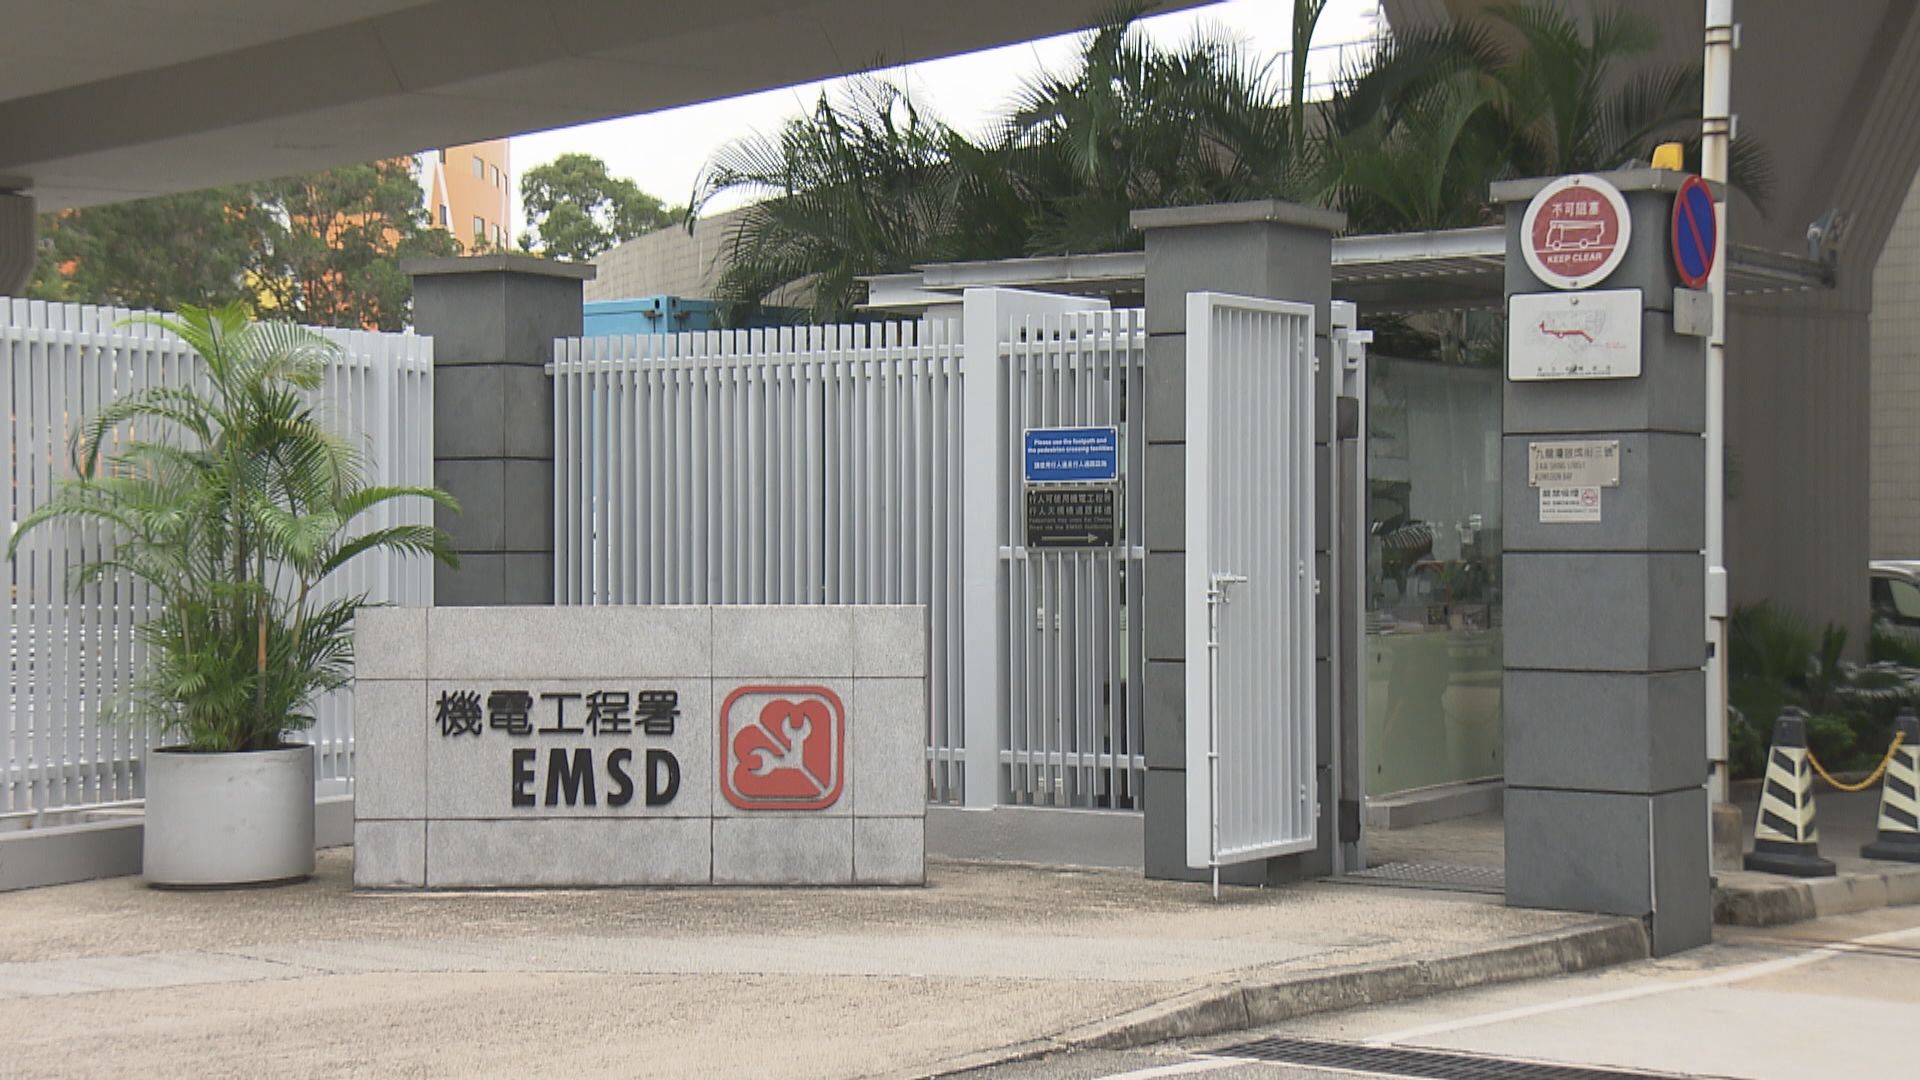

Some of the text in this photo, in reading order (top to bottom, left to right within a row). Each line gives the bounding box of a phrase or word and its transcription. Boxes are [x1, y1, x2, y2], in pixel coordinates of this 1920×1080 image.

[1547, 252, 1602, 264] KEEP CLEAR
[1072, 437, 1095, 446] footpath
[1037, 446, 1066, 455] pedestrian
[1066, 446, 1090, 455] crossing
[435, 689, 681, 737] 機電工程署
[511, 748, 681, 808] EMSD
